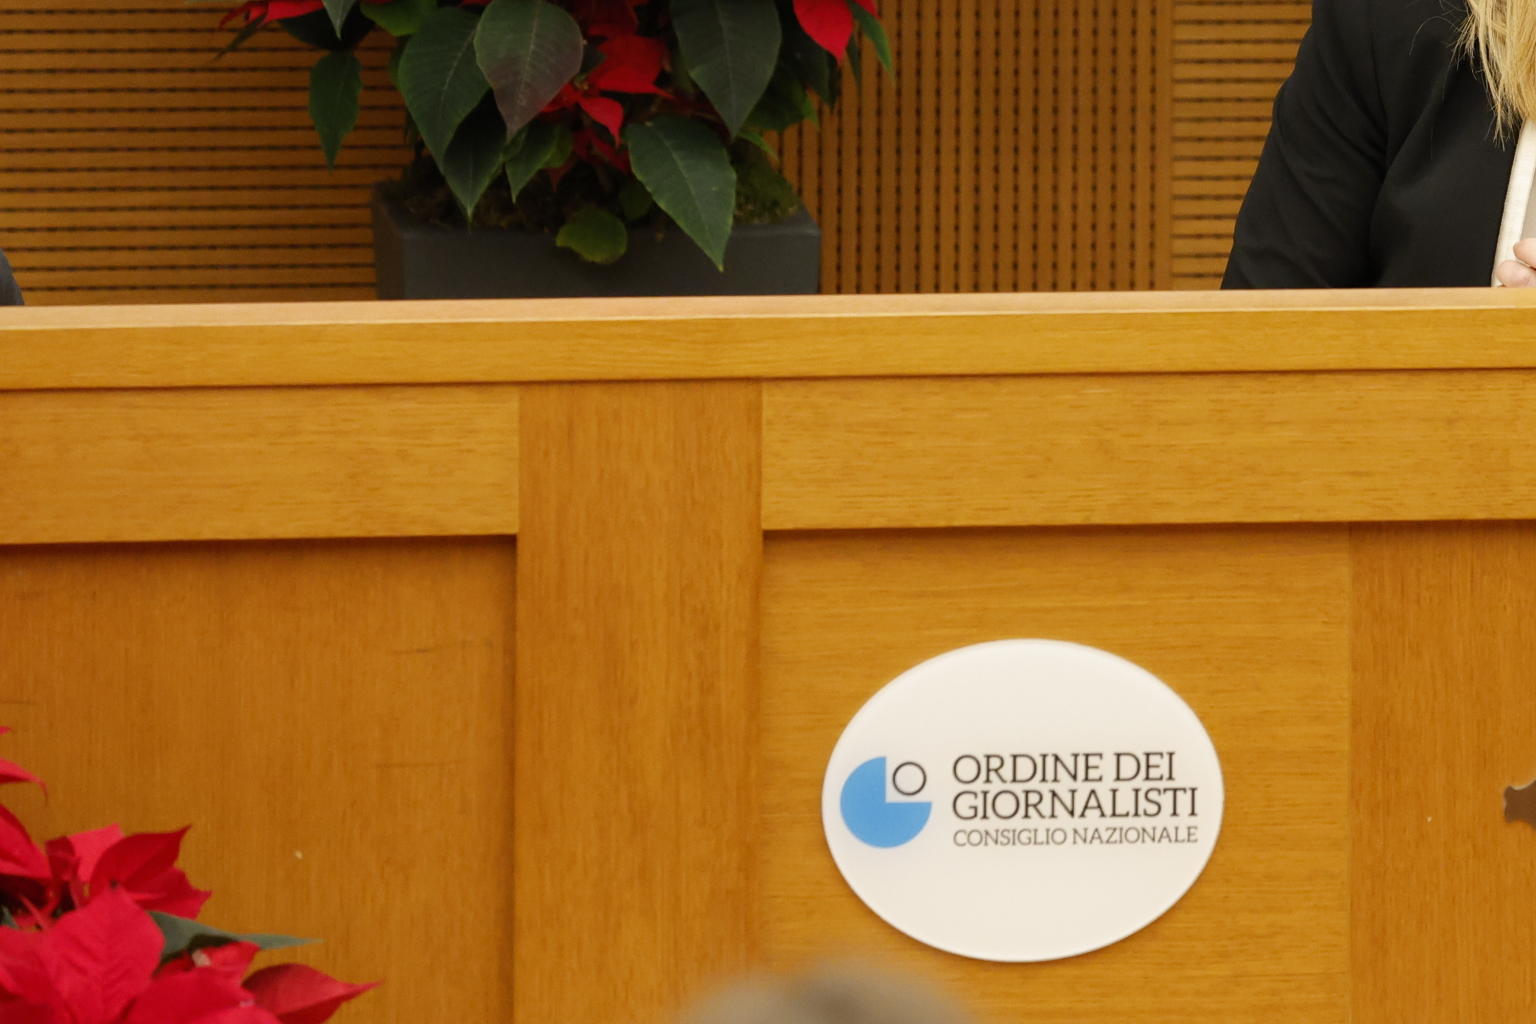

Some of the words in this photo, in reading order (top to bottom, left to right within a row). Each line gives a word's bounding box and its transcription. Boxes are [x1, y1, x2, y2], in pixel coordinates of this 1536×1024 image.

[952, 752, 1103, 785] ORDINE
[1113, 751, 1176, 782] DEI
[952, 787, 1198, 820] GIORNALISTI
[952, 827, 1068, 847] CONSIGLIO
[1072, 825, 1198, 845] NAZIONALE
